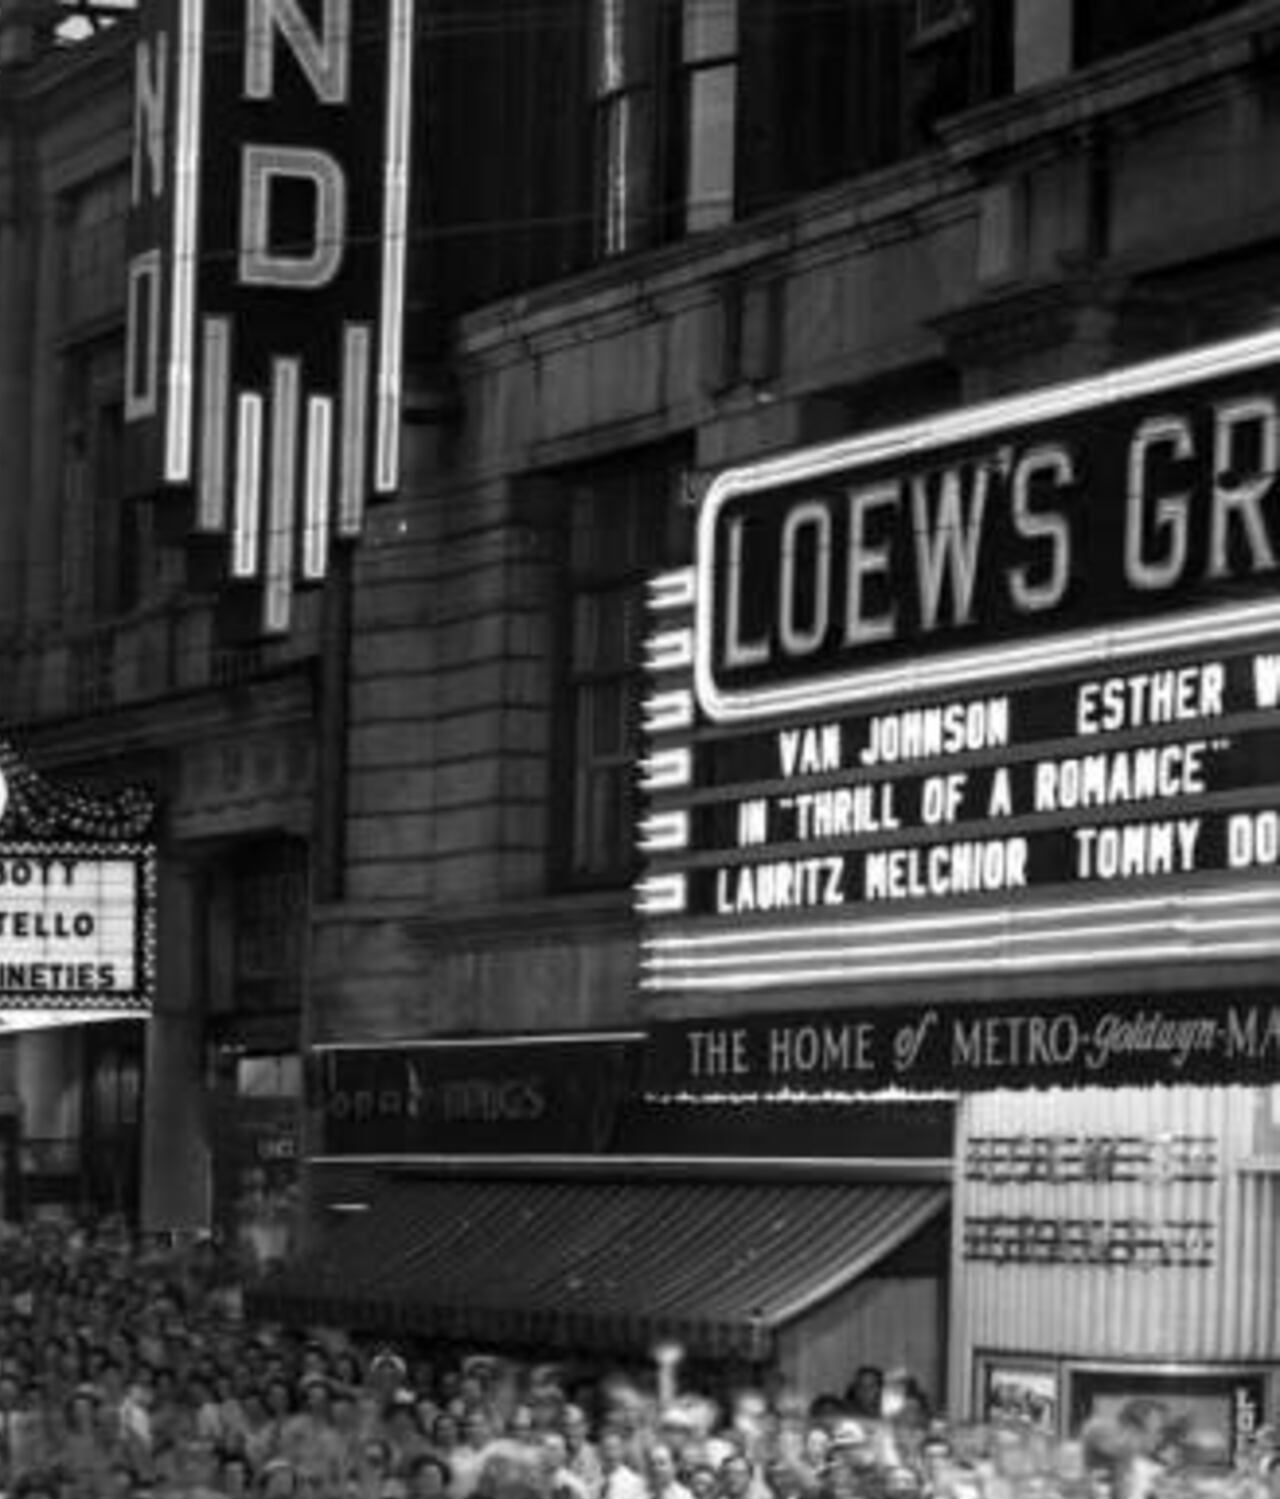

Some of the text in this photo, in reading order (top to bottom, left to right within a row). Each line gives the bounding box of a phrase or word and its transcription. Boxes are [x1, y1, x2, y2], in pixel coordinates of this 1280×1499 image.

[724, 442, 1076, 669] LOEW'S
[779, 723, 841, 778] VAN
[860, 698, 1009, 766] JOHNSON
[1076, 662, 1225, 736] ESTHER
[739, 800, 767, 847] IN
[921, 774, 968, 825] OF
[989, 768, 1013, 818] A
[716, 858, 845, 914] LAURITZ
[864, 838, 1029, 901] MELCHIOR
[1075, 818, 1202, 880] TOMMY
[687, 1028, 750, 1076] THE
[768, 1023, 876, 1073] HOME
[893, 1009, 939, 1072] of
